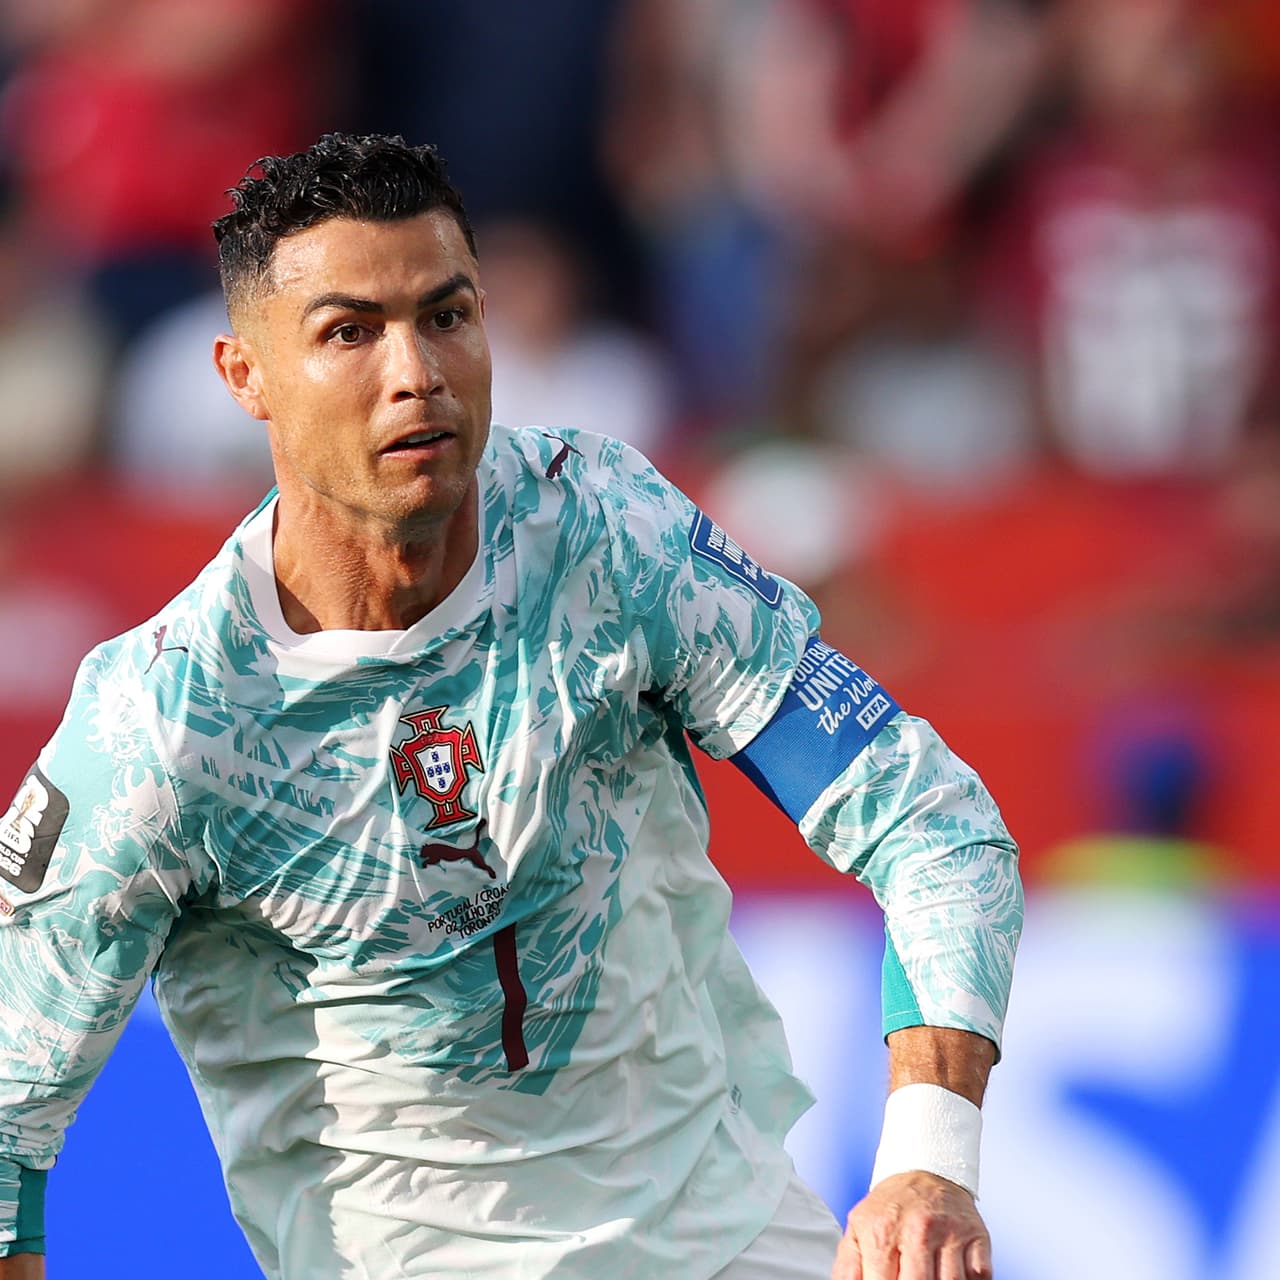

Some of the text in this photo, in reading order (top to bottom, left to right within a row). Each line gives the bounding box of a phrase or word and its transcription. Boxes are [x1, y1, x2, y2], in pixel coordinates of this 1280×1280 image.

[797, 652, 861, 711] UNITE
[816, 701, 851, 735] the
[860, 697, 889, 727] FIFA
[428, 897, 473, 933] PORTUGAL
[445, 920, 460, 935] 02
[459, 905, 486, 928] JULHO
